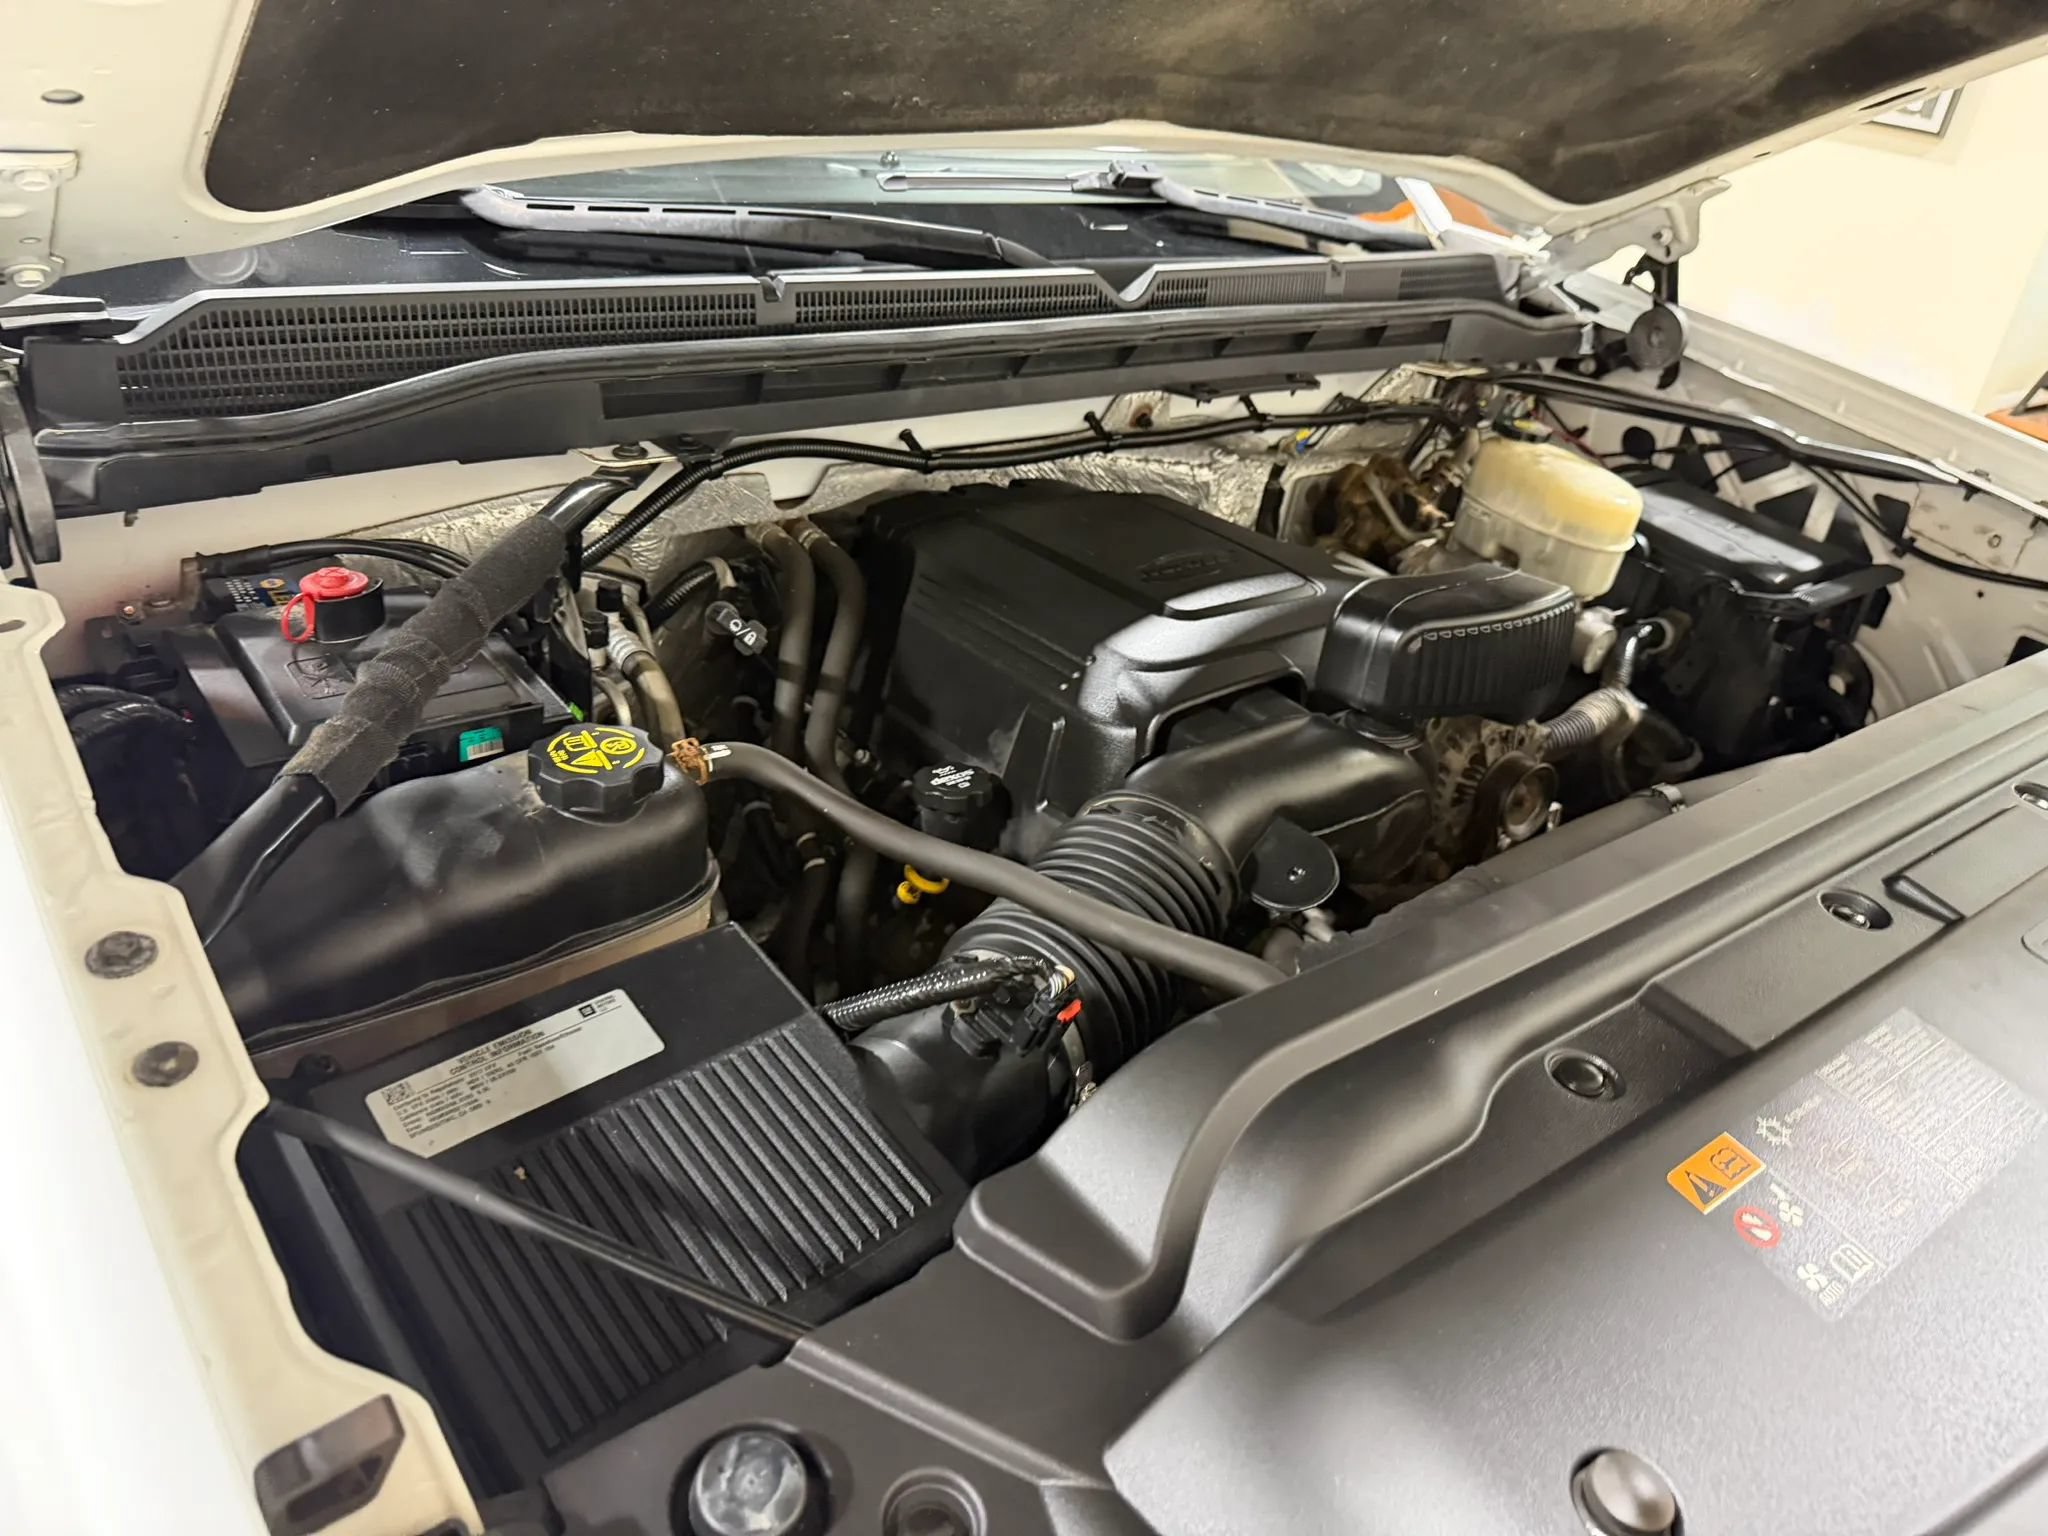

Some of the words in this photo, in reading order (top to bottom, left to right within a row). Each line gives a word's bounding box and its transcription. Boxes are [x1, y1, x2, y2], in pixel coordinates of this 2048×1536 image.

[448, 1054, 489, 1075] CONTROL
[489, 1030, 545, 1058] INFORMATION
[491, 1027, 533, 1049] EMISSION
